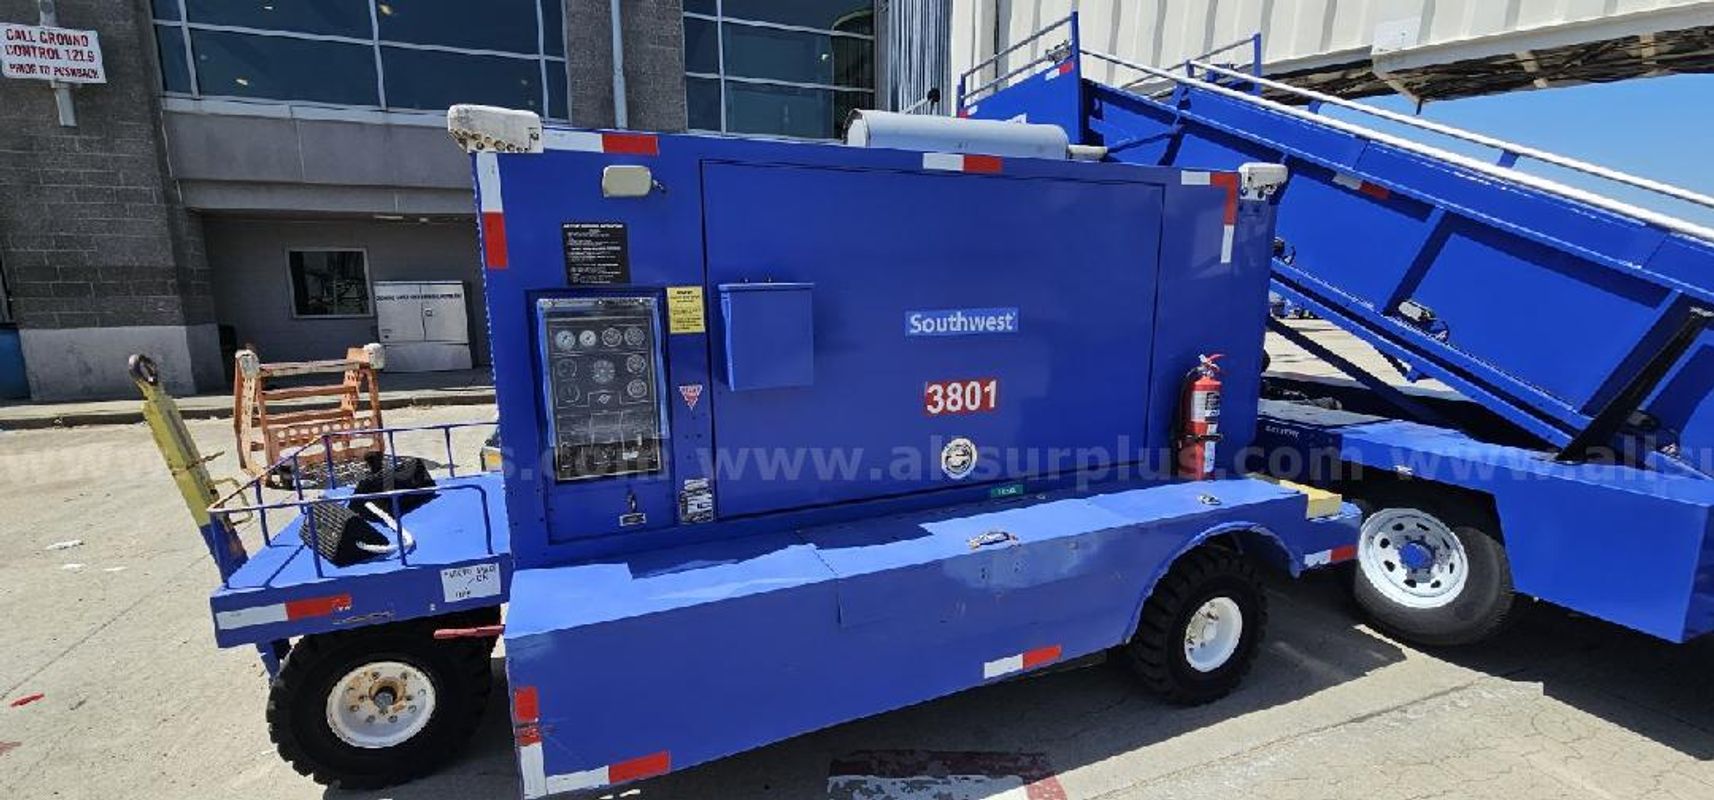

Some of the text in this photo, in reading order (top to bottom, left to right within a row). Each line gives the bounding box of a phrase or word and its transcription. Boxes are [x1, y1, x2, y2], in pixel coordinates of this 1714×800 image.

[6, 28, 89, 47] CALL GROUND
[5, 44, 62, 60] CONTROL
[9, 63, 37, 74] PRIOR
[40, 65, 50, 75] TO
[909, 311, 1014, 333] Southwest
[926, 380, 997, 414] 3801
